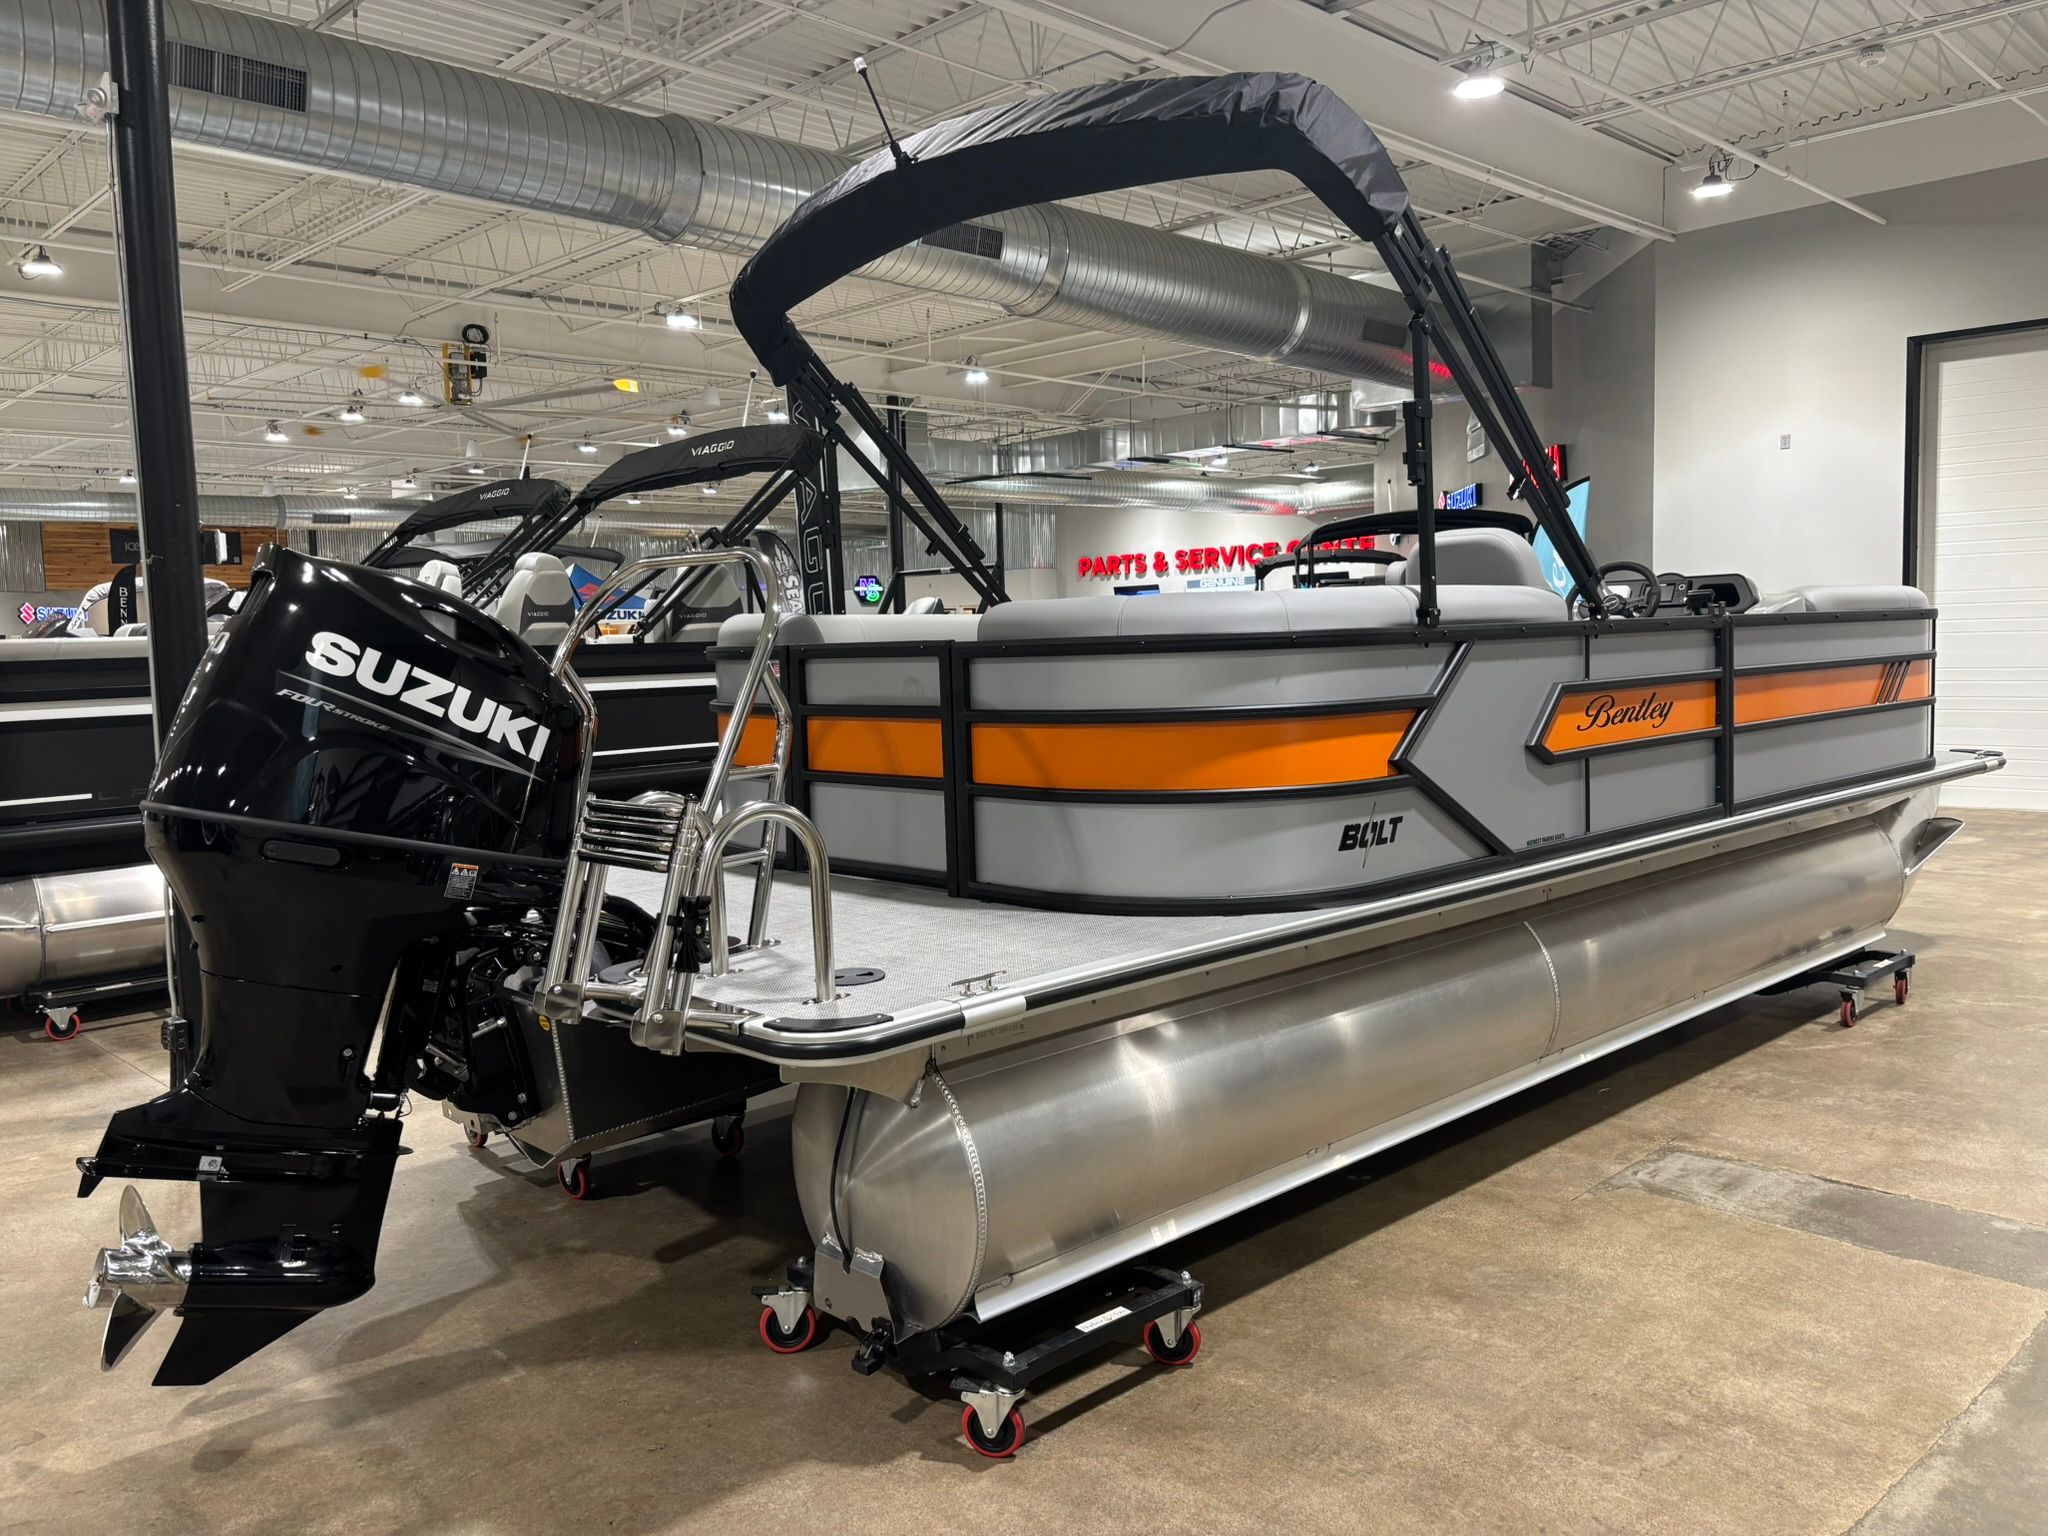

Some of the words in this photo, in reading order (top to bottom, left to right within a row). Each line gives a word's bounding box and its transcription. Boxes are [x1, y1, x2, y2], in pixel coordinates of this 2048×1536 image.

[691, 440, 735, 456] VIAGGIO
[479, 487, 510, 501] VIAGGIO
[1078, 554, 1148, 577] PARTS
[1153, 551, 1168, 573] &
[1175, 541, 1280, 571] SERVICE
[305, 631, 551, 763] SUZUKI
[1577, 692, 1674, 731] Bentley
[1338, 815, 1404, 852] BOLT
